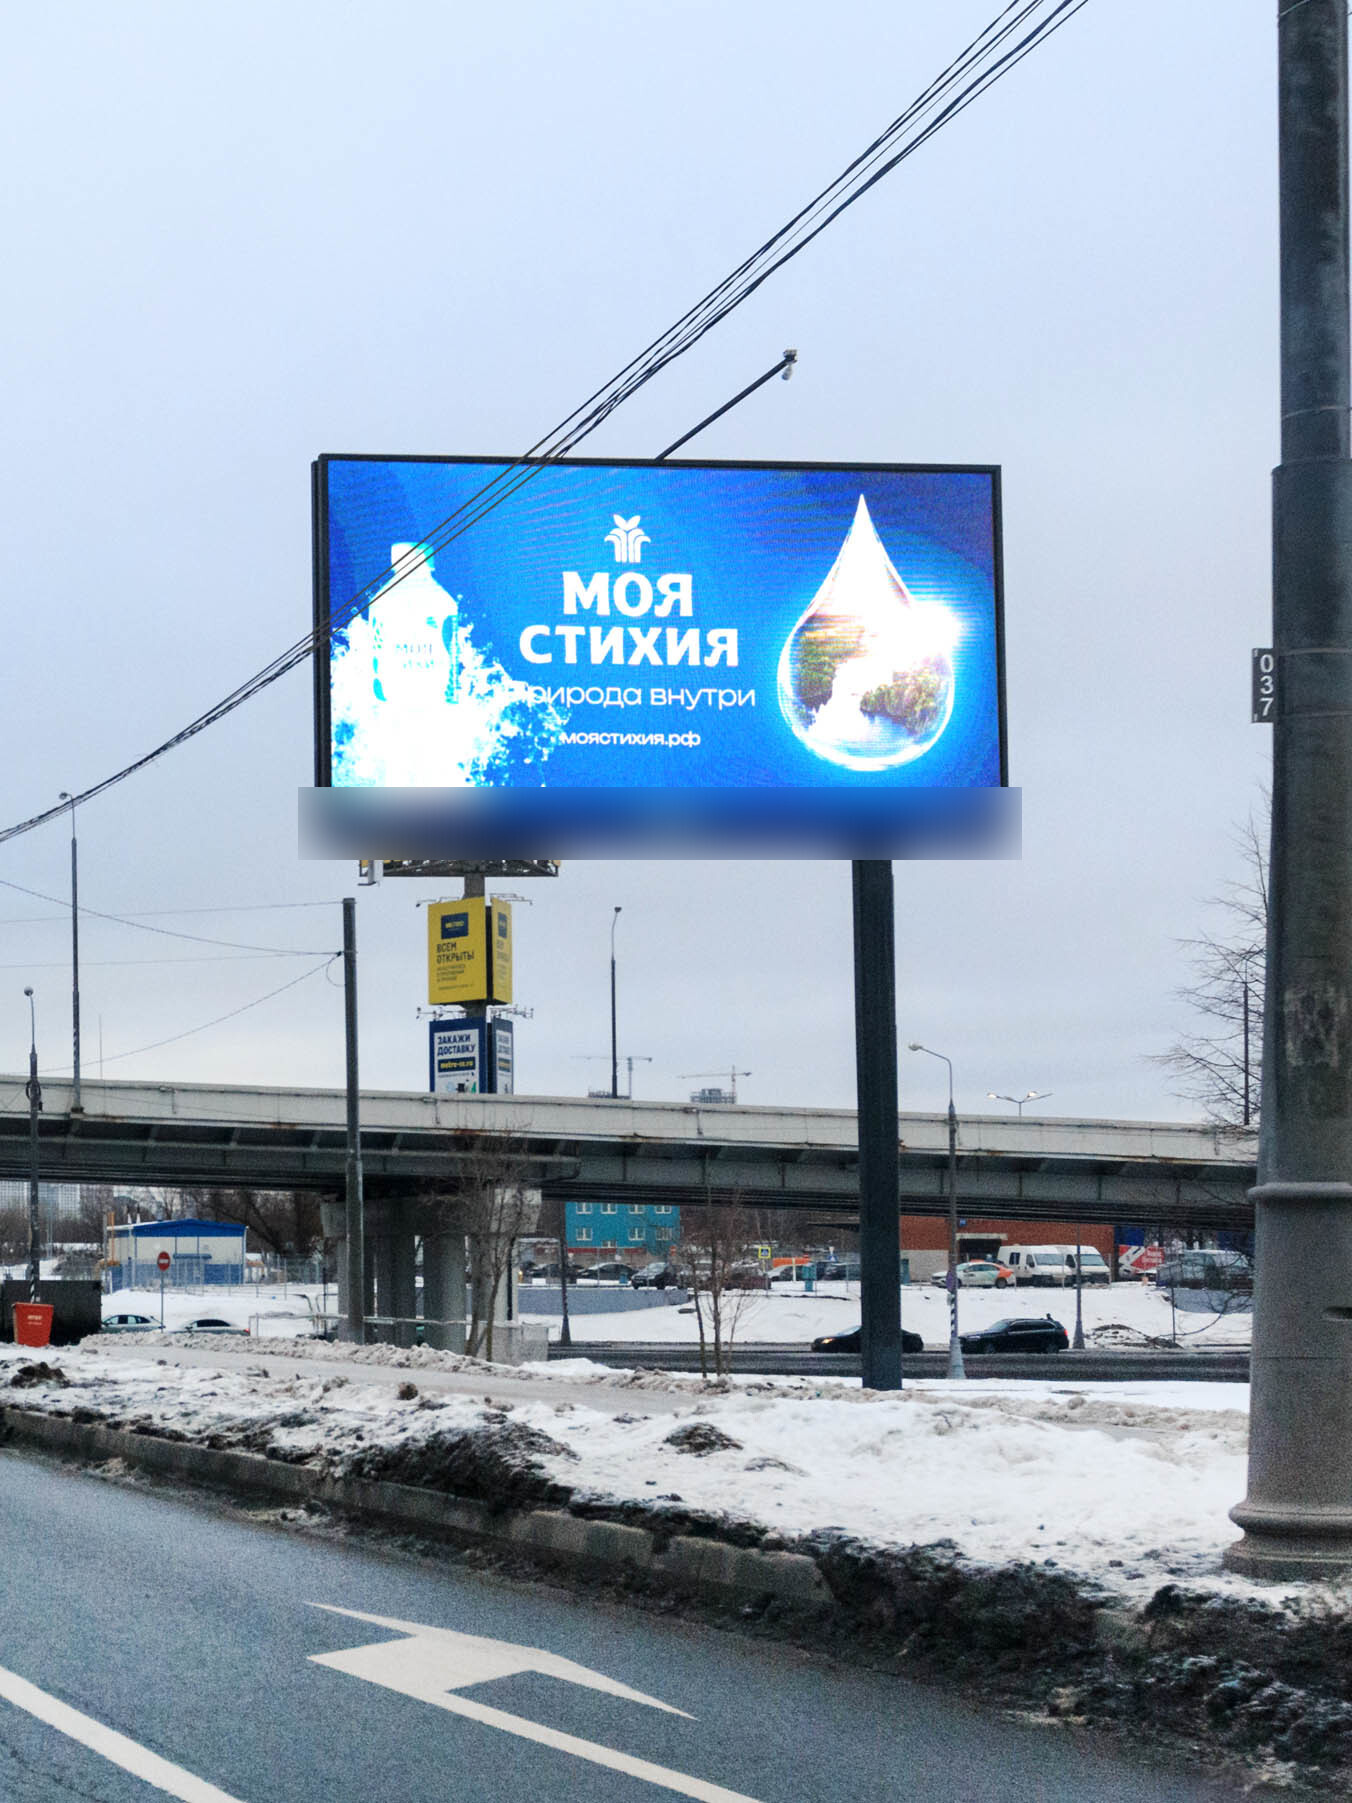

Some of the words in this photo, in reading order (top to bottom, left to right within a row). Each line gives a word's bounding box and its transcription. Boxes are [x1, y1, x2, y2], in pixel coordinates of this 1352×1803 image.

[562, 571, 693, 617] МОЯ
[519, 624, 739, 667] СТИХИЯ
[1259, 654, 1274, 717] 037
[650, 688, 756, 710] внутри
[562, 730, 701, 748] моястихия.рф
[436, 942, 457, 953] ВСЕМ
[436, 950, 475, 964] ОТКРЫТЫ
[437, 1034, 471, 1045] ЗАКАЖИ
[437, 1044, 476, 1056] ДОСТАВКУ
